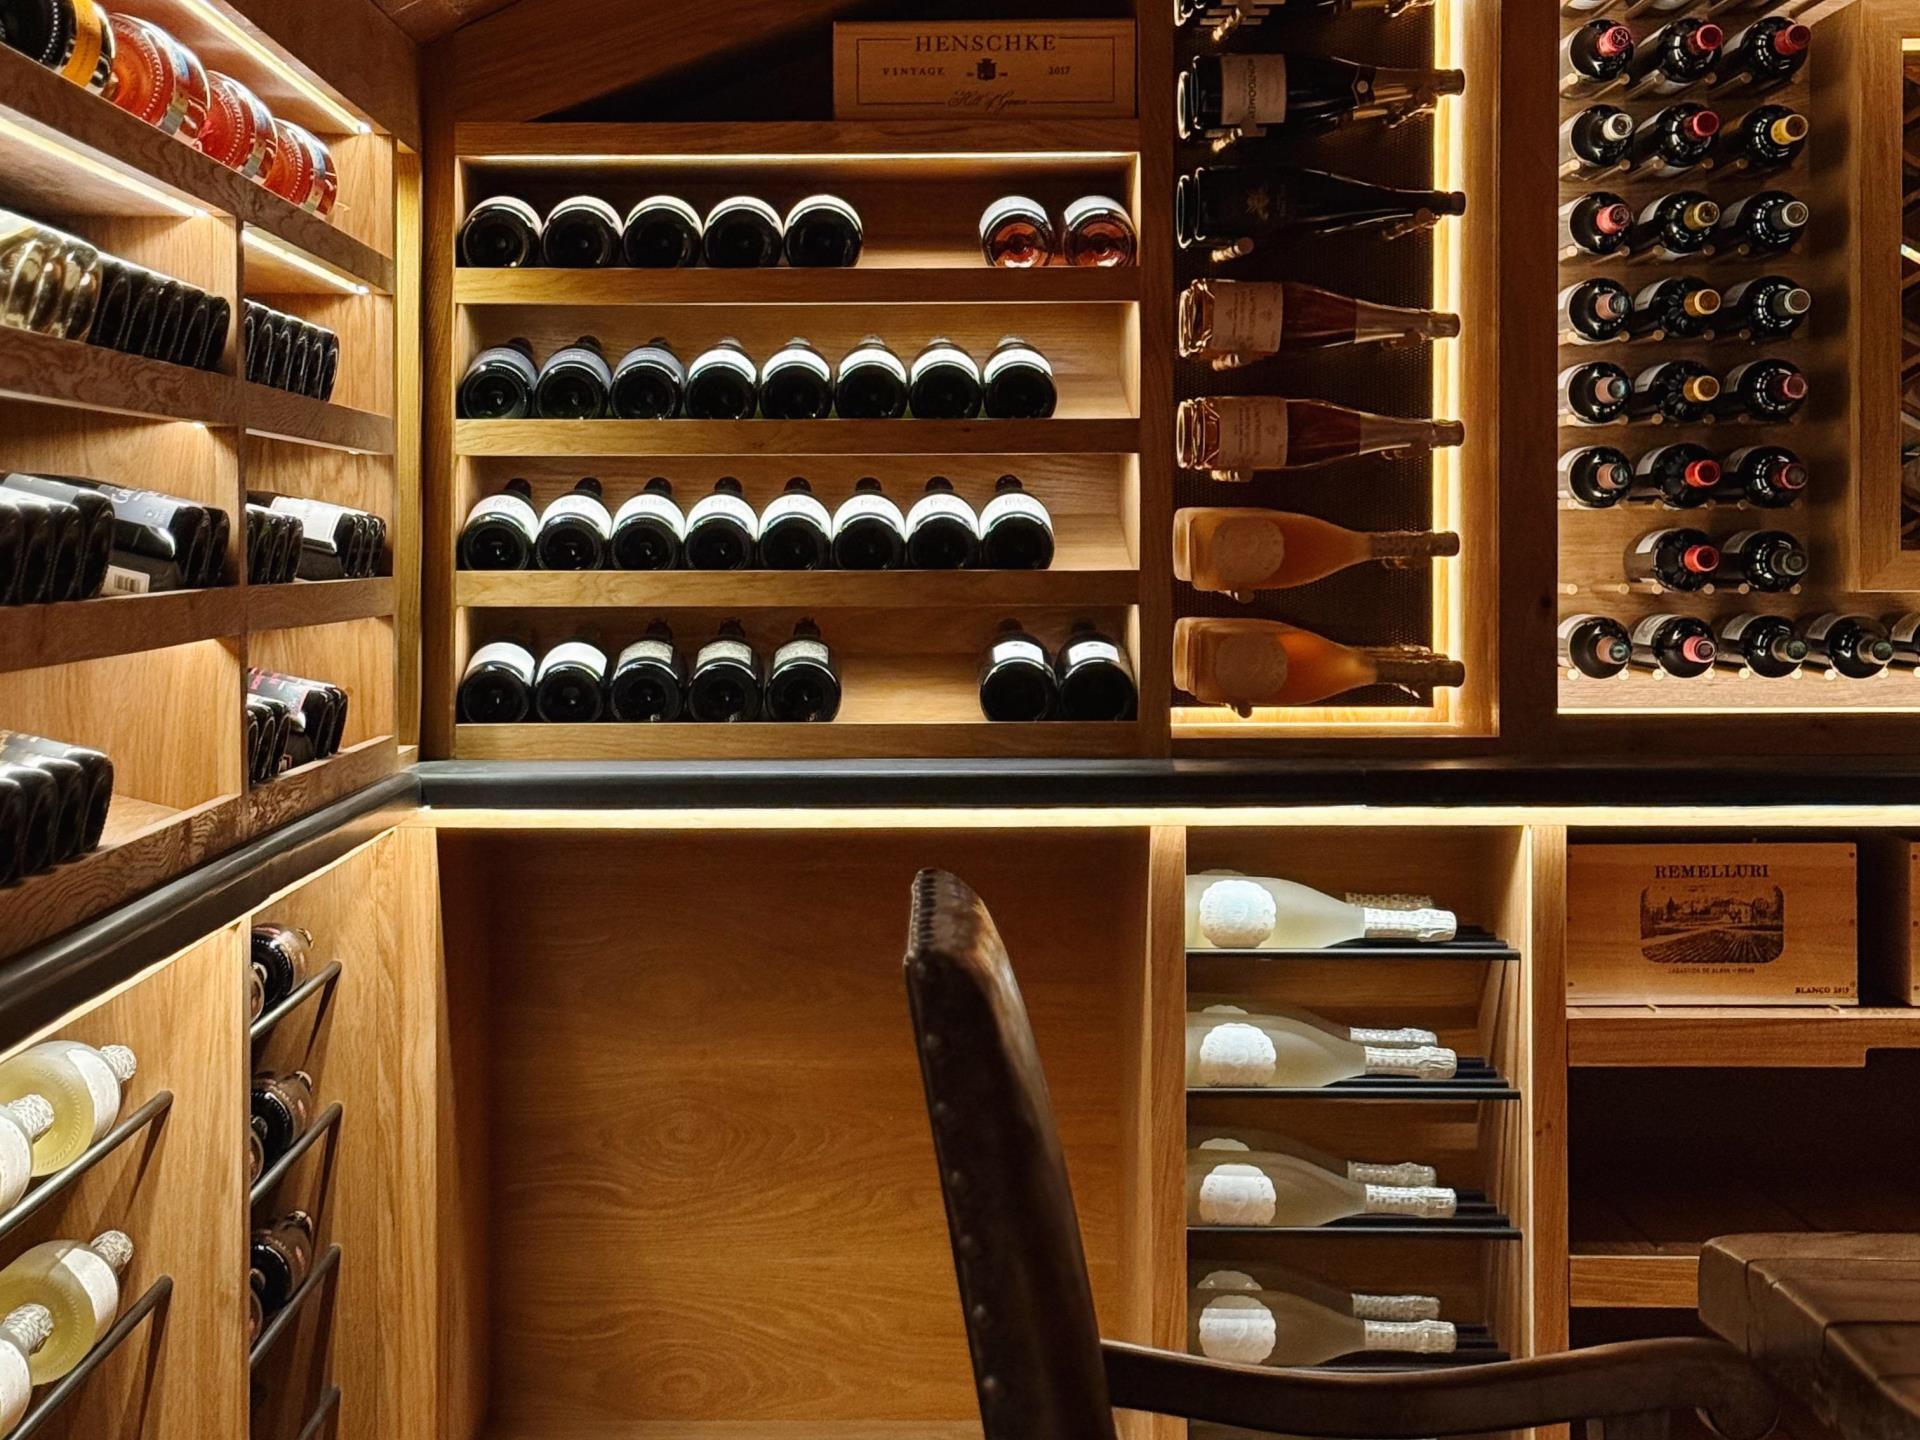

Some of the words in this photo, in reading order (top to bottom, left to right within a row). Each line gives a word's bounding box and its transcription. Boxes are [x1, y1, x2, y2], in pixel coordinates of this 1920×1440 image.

[914, 34, 1056, 52] HENSCHKE
[882, 66, 945, 76] VINTAGE
[1654, 864, 1770, 879] REMELLURI
[1795, 986, 1831, 994] BLANCO
